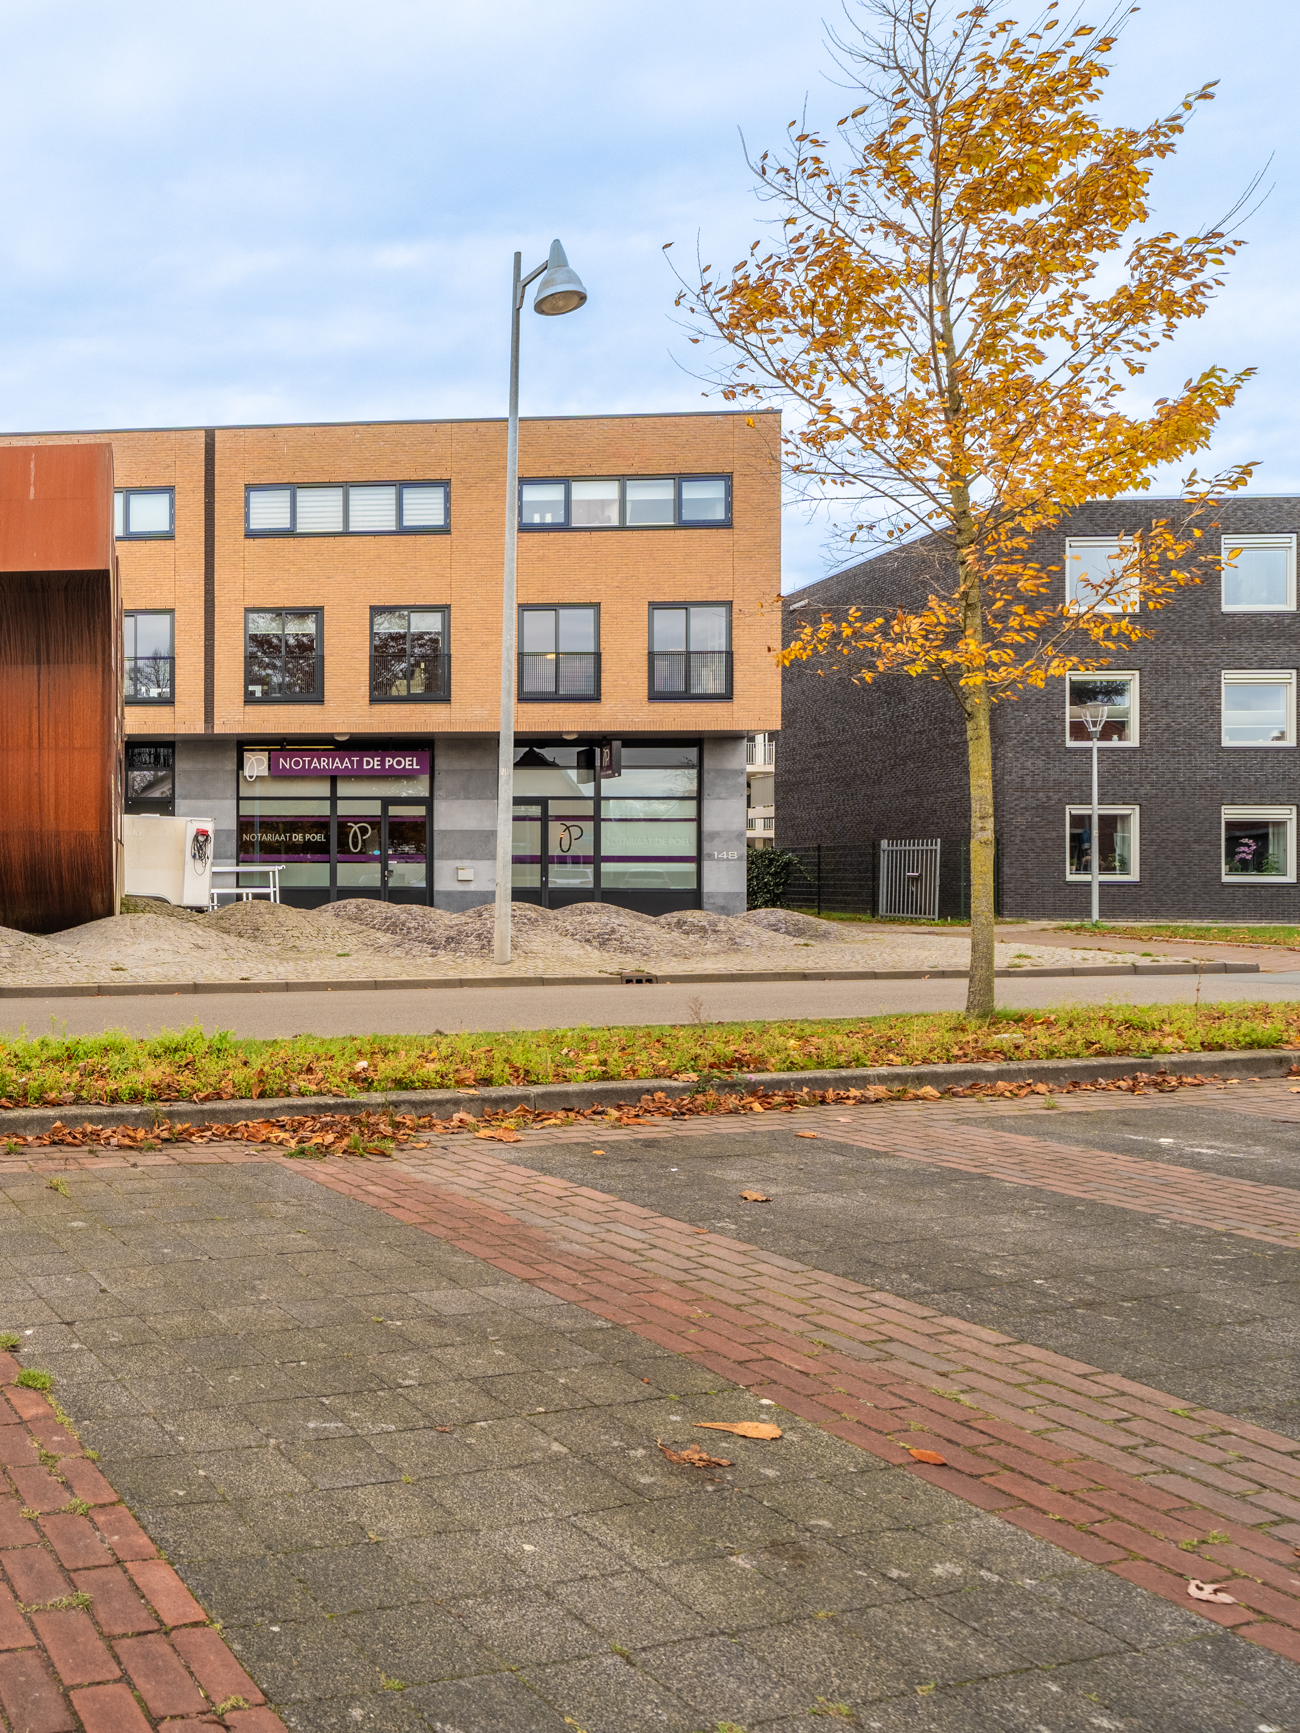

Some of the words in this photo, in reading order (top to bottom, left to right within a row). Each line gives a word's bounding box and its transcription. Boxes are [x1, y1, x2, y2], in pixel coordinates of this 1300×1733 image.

[279, 757, 360, 770] NOTARIAAT
[363, 757, 382, 770] DE
[385, 757, 420, 770] POEL
[242, 833, 291, 842] NOTARIAAT
[292, 833, 304, 842] DE
[305, 833, 326, 842] POEL
[604, 836, 654, 846] NOTARIAAT
[655, 836, 668, 846] DE
[669, 836, 693, 846] POEL
[713, 851, 738, 859] 148
